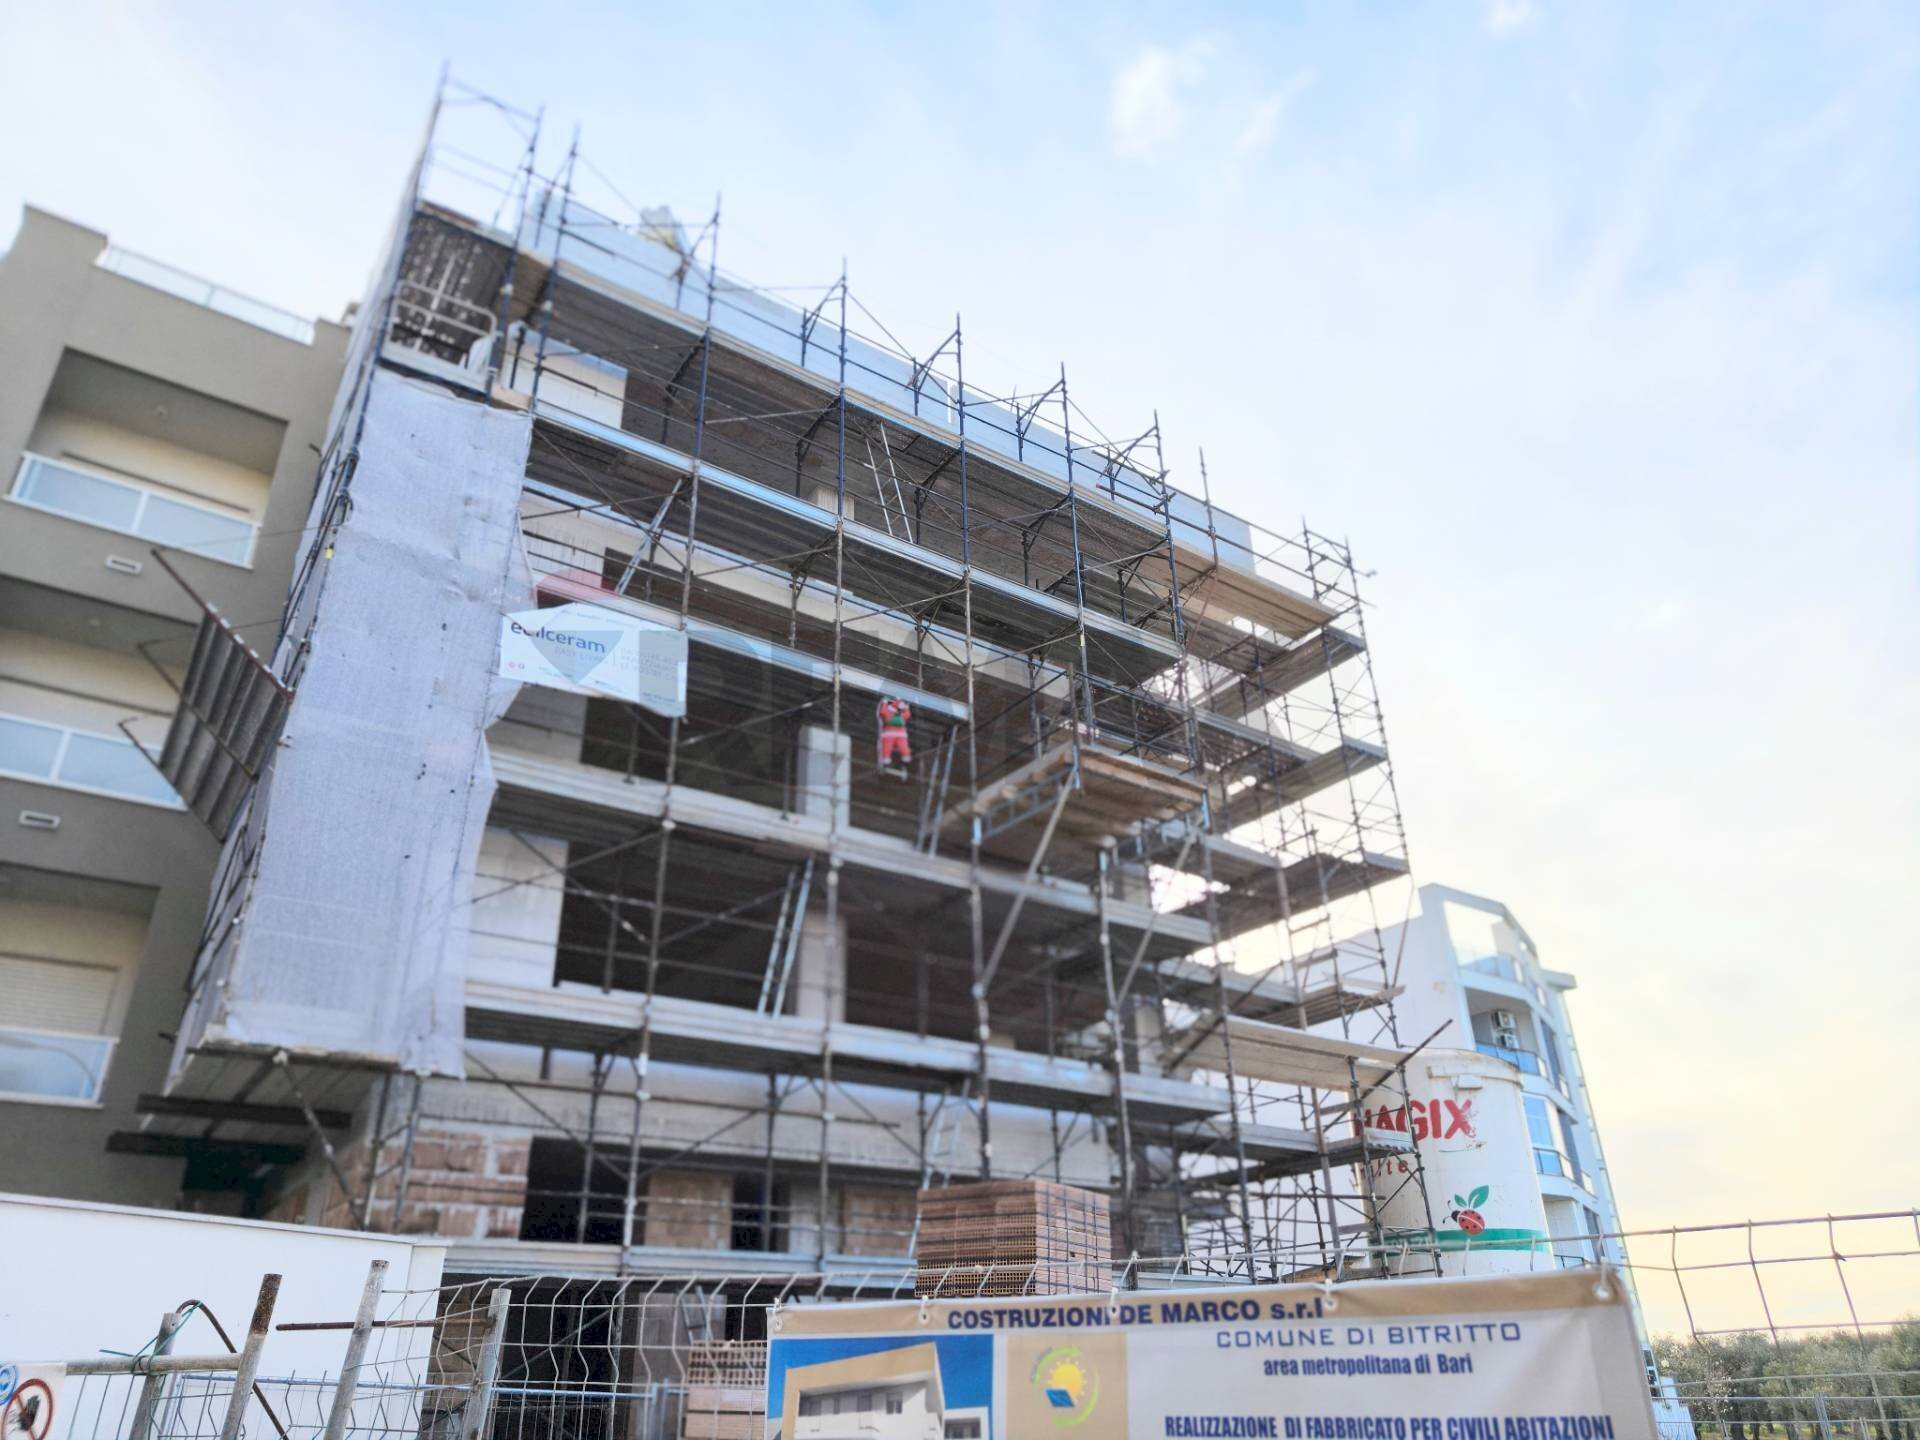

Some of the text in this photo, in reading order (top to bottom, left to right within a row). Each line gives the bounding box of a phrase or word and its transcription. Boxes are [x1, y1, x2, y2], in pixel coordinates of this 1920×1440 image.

[947, 1305, 1110, 1330] COSTRUZIONI
[1120, 1304, 1152, 1326] DE
[1161, 1299, 1260, 1323] MARCO
[1216, 1322, 1521, 1348] COMUNE DI BITRITTO
[1264, 1352, 1473, 1377] area metropolitana di Bari
[1165, 1415, 1615, 1440] REALIZZAZIONE DI FABBRICATO PER CIVILI ABITAZIONI
